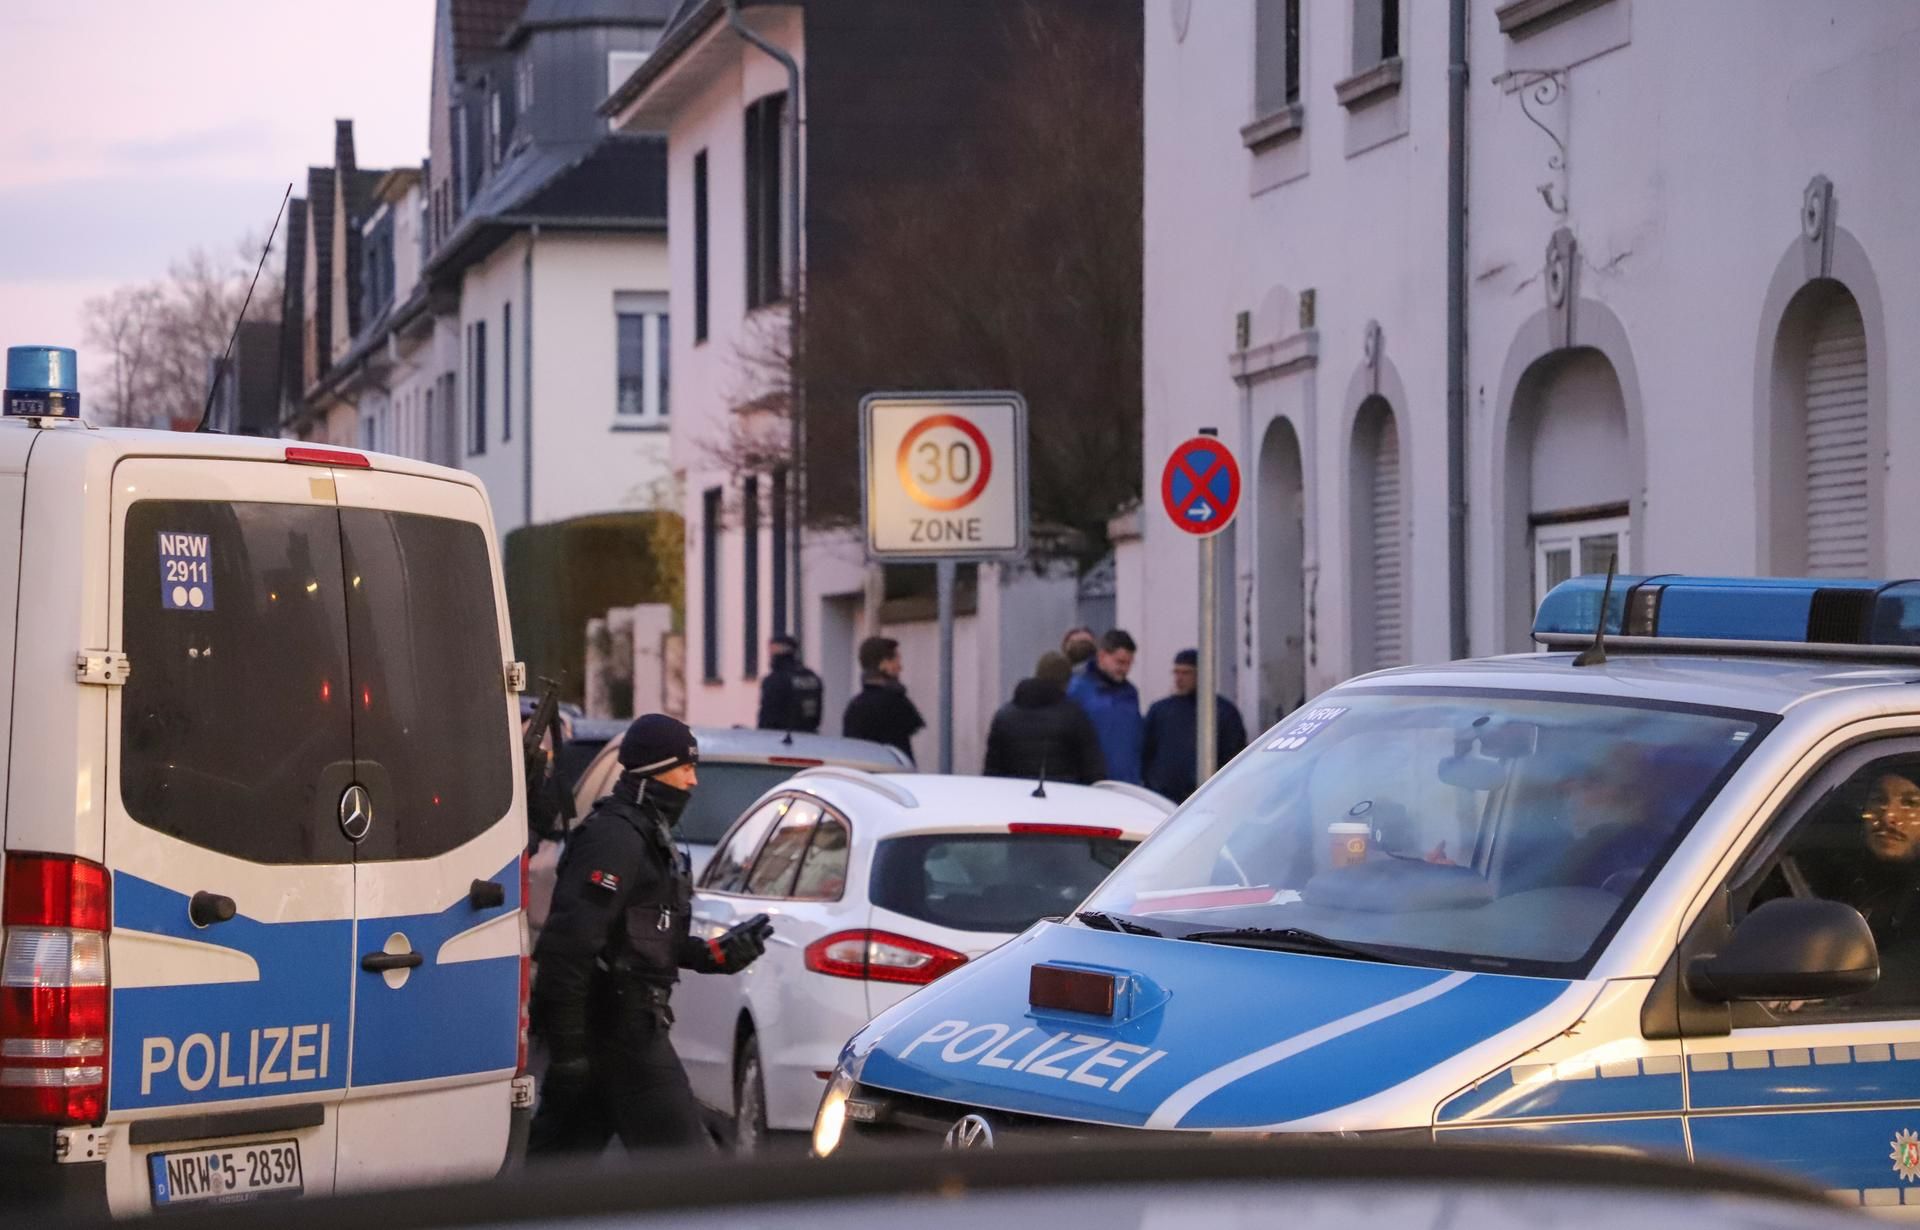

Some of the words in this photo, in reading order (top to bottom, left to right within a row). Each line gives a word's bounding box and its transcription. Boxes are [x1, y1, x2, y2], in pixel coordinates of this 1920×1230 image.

[918, 442, 971, 484] 30
[160, 534, 207, 557] NRW
[910, 518, 982, 542] ZONE
[166, 560, 208, 583] 2911
[1302, 707, 1347, 720] NRW
[141, 1023, 330, 1095] POLIZEI
[897, 1020, 1168, 1093] POLIZEI
[167, 1156, 211, 1196] NRW
[222, 1148, 297, 1190] 5-2839
